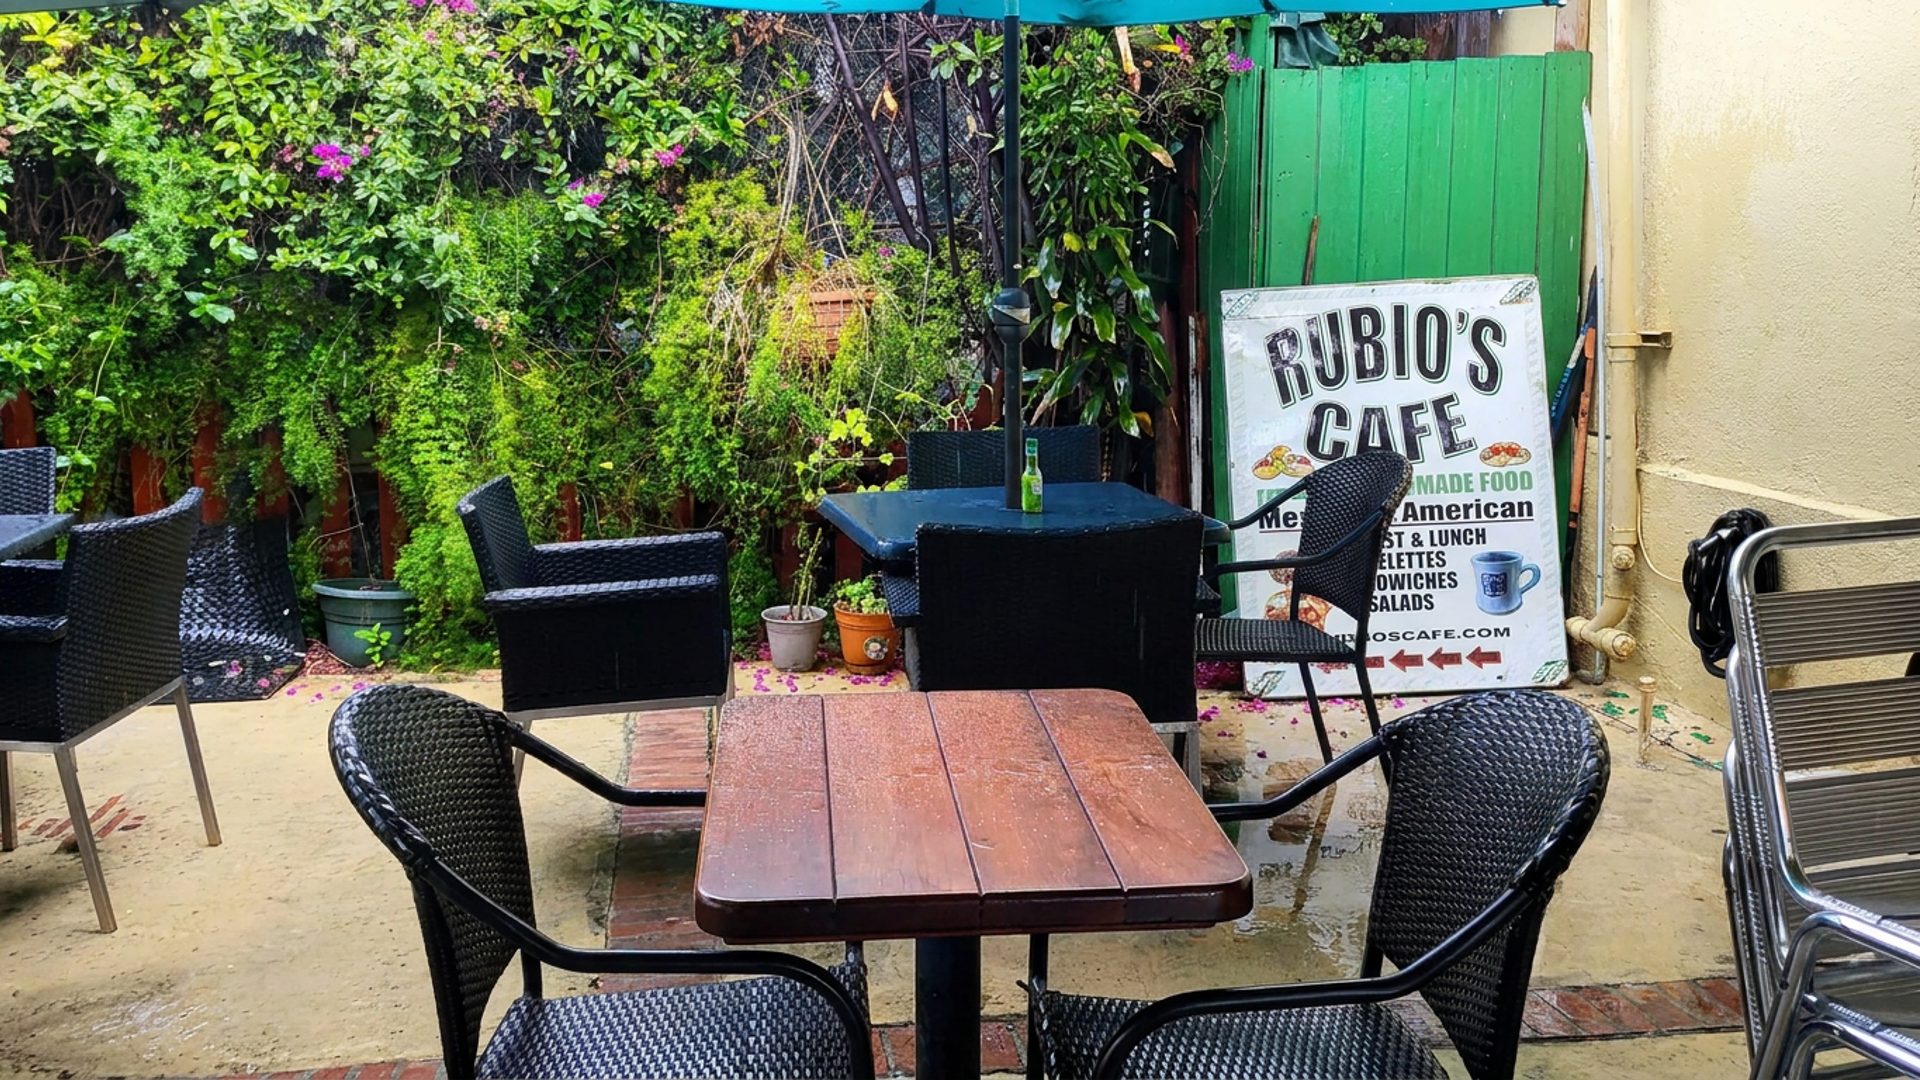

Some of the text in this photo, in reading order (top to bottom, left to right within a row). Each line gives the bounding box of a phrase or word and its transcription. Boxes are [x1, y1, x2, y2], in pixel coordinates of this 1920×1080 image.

[1265, 303, 1506, 408] RUBIO'S
[1304, 392, 1478, 464] CAFE
[1409, 470, 1533, 496] MADE FOOD
[1402, 499, 1534, 522] American
[1410, 532, 1424, 548] &
[1429, 528, 1487, 547] LUNCH
[1379, 550, 1447, 570] ELETTES
[1369, 593, 1435, 613] SALADS
